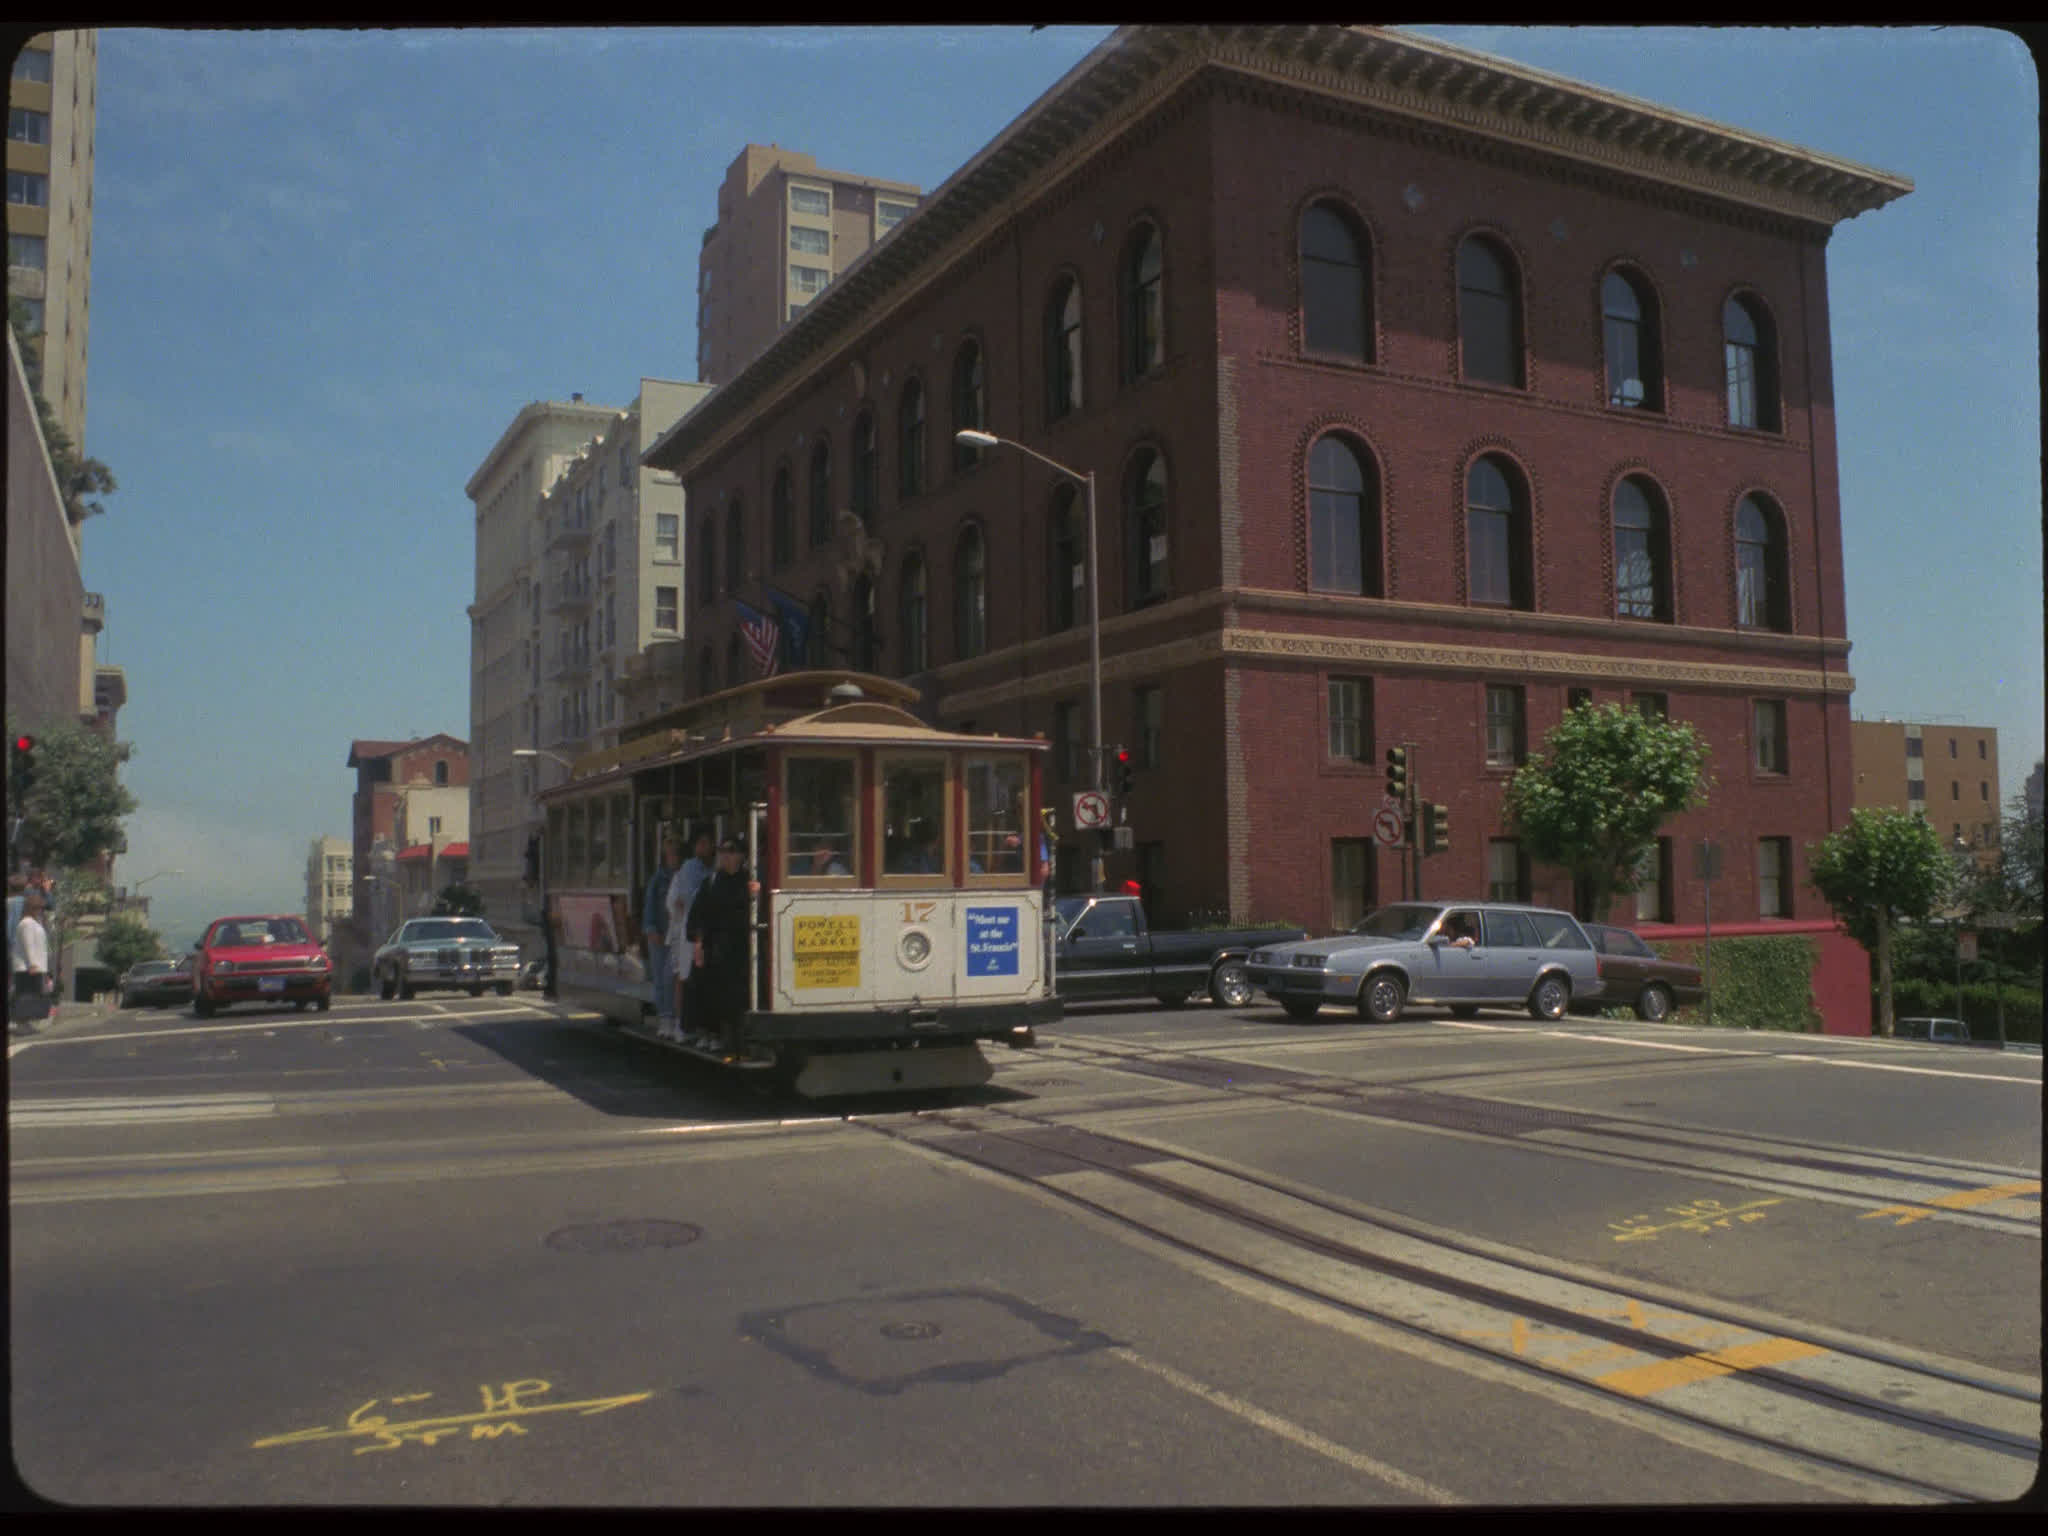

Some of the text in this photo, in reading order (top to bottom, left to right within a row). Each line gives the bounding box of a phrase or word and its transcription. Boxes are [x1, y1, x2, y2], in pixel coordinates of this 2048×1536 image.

[902, 902, 937, 923] 17
[797, 919, 857, 929] POWELL
[797, 936, 857, 947] MARKET
